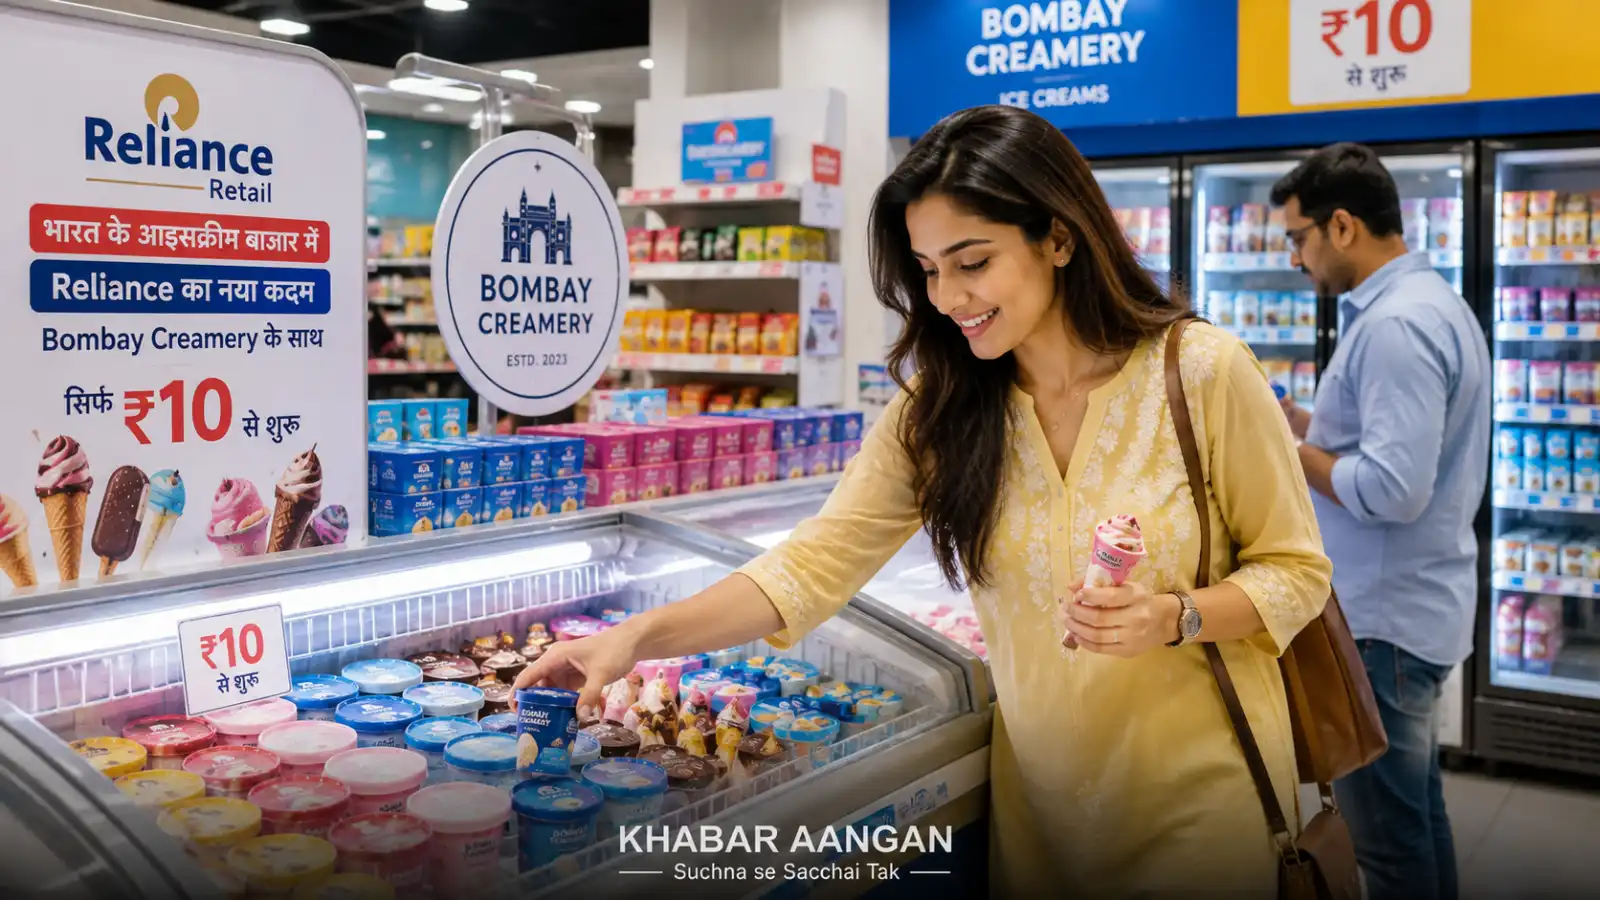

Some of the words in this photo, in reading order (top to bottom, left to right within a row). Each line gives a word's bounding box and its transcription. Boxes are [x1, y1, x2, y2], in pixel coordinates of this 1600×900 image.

[981, 0, 1128, 39] BOMBAY
[1321, 0, 1433, 57] ₹10
[966, 30, 1145, 76] CREAMERY
[1345, 63, 1363, 87] से
[999, 90, 1029, 110] ICE
[1032, 83, 1110, 108] CREAMS
[84, 112, 274, 177] Reliance
[210, 179, 272, 203] Retail
[43, 219, 101, 244] भारत
[107, 214, 131, 245] के
[138, 220, 240, 251] आइसक्रीम
[245, 230, 299, 252] बाजार
[303, 226, 320, 253] में
[52, 272, 174, 301] Reliance
[180, 278, 213, 301] का
[217, 279, 258, 302] नया
[263, 280, 316, 305] कदम
[480, 273, 593, 303] BOMBAY
[42, 326, 145, 356] Bombay
[151, 327, 258, 354] Creamery
[263, 322, 283, 349] के
[287, 328, 325, 349] साथ
[478, 311, 594, 335] CREAMERY
[506, 353, 540, 368] ESTD.
[542, 353, 568, 366] 2023
[64, 384, 114, 415] सिर्फ
[124, 377, 233, 445] ₹10
[242, 410, 260, 438] से
[200, 623, 264, 670] ₹10
[216, 672, 230, 694] से
